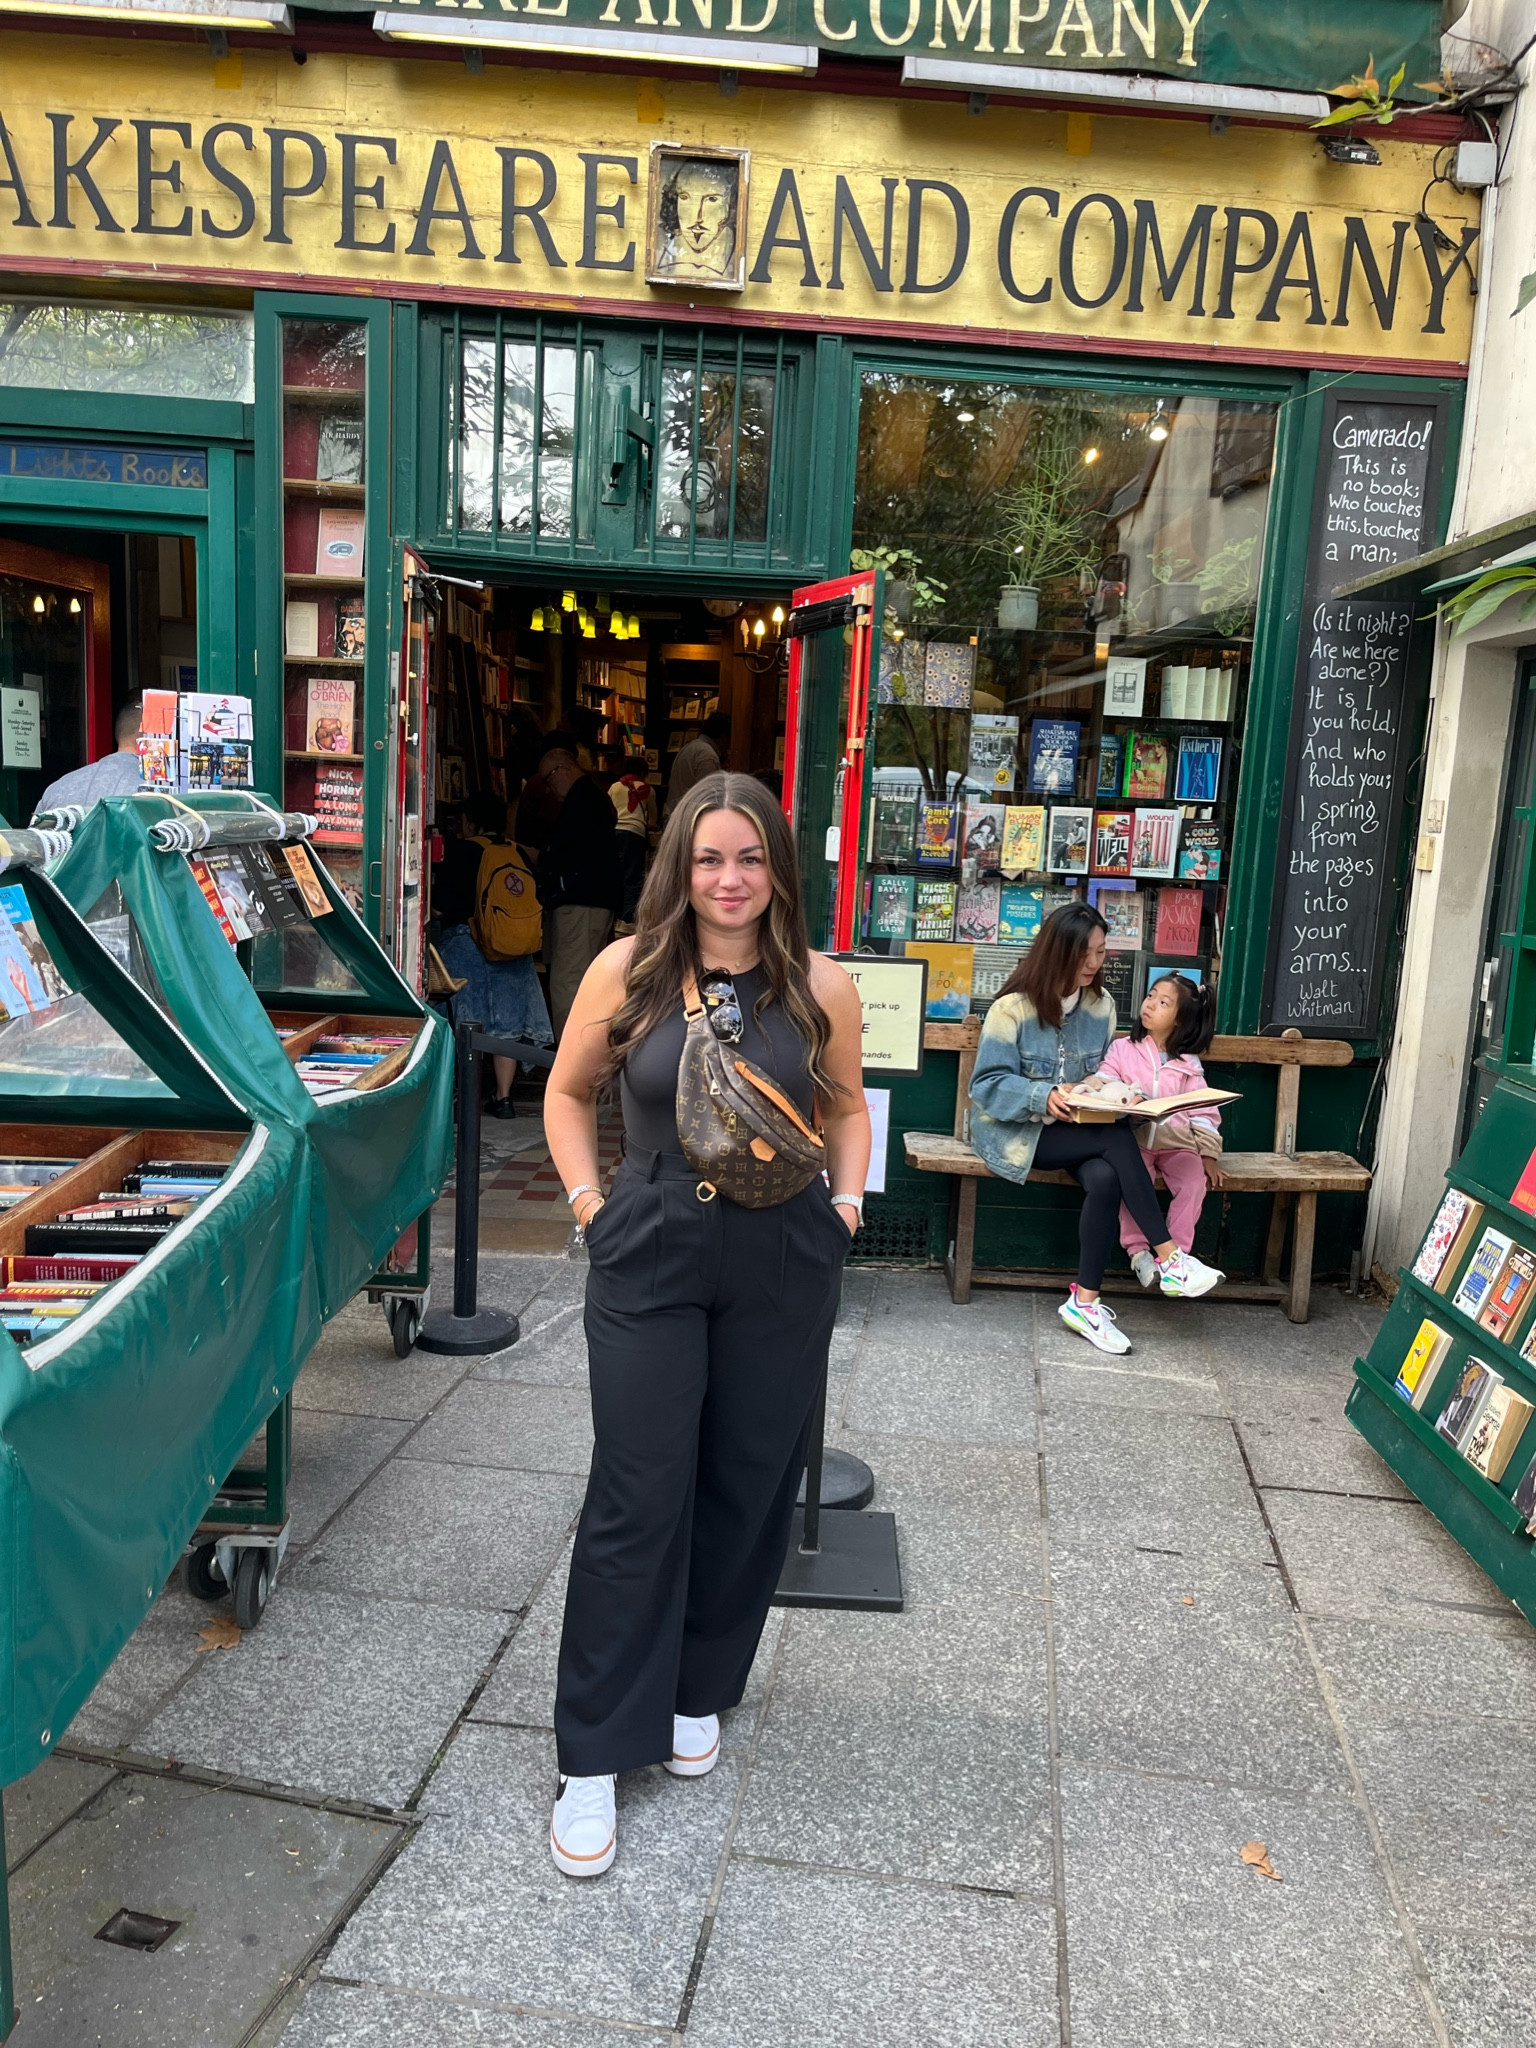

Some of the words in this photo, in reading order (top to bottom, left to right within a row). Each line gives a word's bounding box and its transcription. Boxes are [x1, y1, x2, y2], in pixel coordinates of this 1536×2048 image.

[813, 0, 1203, 66] COMPANY
[748, 167, 971, 294] AND
[997, 186, 1480, 334] COMPANY
[1332, 415, 1433, 450] Camerado!
[1338, 454, 1380, 475] This
[1390, 456, 1407, 475] is
[1343, 479, 1363, 492] no
[1363, 495, 1422, 518] touches
[1326, 513, 1361, 534] this,
[1363, 516, 1420, 542] touches
[1325, 542, 1339, 562] a
[1312, 602, 1333, 632] (Is
[1338, 604, 1352, 632] it
[1357, 610, 1410, 643] night?
[1309, 636, 1338, 659] Are
[1342, 645, 1361, 658] we
[1364, 641, 1400, 662] here
[1318, 659, 1390, 688] alone?)
[310, 690, 352, 703] O'BRIEN
[316, 681, 345, 692] EDNA
[1308, 685, 1325, 710] It
[1338, 687, 1355, 709] is
[1366, 684, 1374, 711] I
[1307, 716, 1343, 737] you
[1348, 707, 1396, 736] hold,
[1181, 739, 1209, 753] Esther
[1211, 739, 1220, 754] Yi
[1301, 737, 1343, 760] And
[1353, 737, 1386, 761] who
[328, 768, 354, 781] NICK
[1308, 761, 1355, 788] holds
[319, 783, 363, 797] HORNBY
[324, 800, 331, 809] A
[333, 800, 358, 812] LONG
[1300, 794, 1305, 822] I
[1317, 798, 1380, 834] spring
[316, 814, 336, 825] WAY
[336, 816, 363, 827] DOWN
[1147, 814, 1175, 822] wound
[1185, 836, 1219, 847] WORLD
[1191, 827, 1216, 837] COLD
[1308, 821, 1357, 853] from
[1097, 838, 1128, 866] WEIL
[1289, 850, 1320, 875] the
[1324, 856, 1374, 888] pages
[877, 885, 910, 894] BAYLEY
[1303, 887, 1349, 914] into
[877, 918, 906, 926] GREEN
[883, 911, 900, 919] THE
[880, 925, 902, 933] LADY
[1291, 923, 1347, 952] your
[1299, 979, 1339, 1000] Walt
[868, 1002, 887, 1010] pick
[889, 1004, 900, 1012] up
[1287, 999, 1355, 1018] Whitman
[1472, 1435, 1485, 1455] TWO
